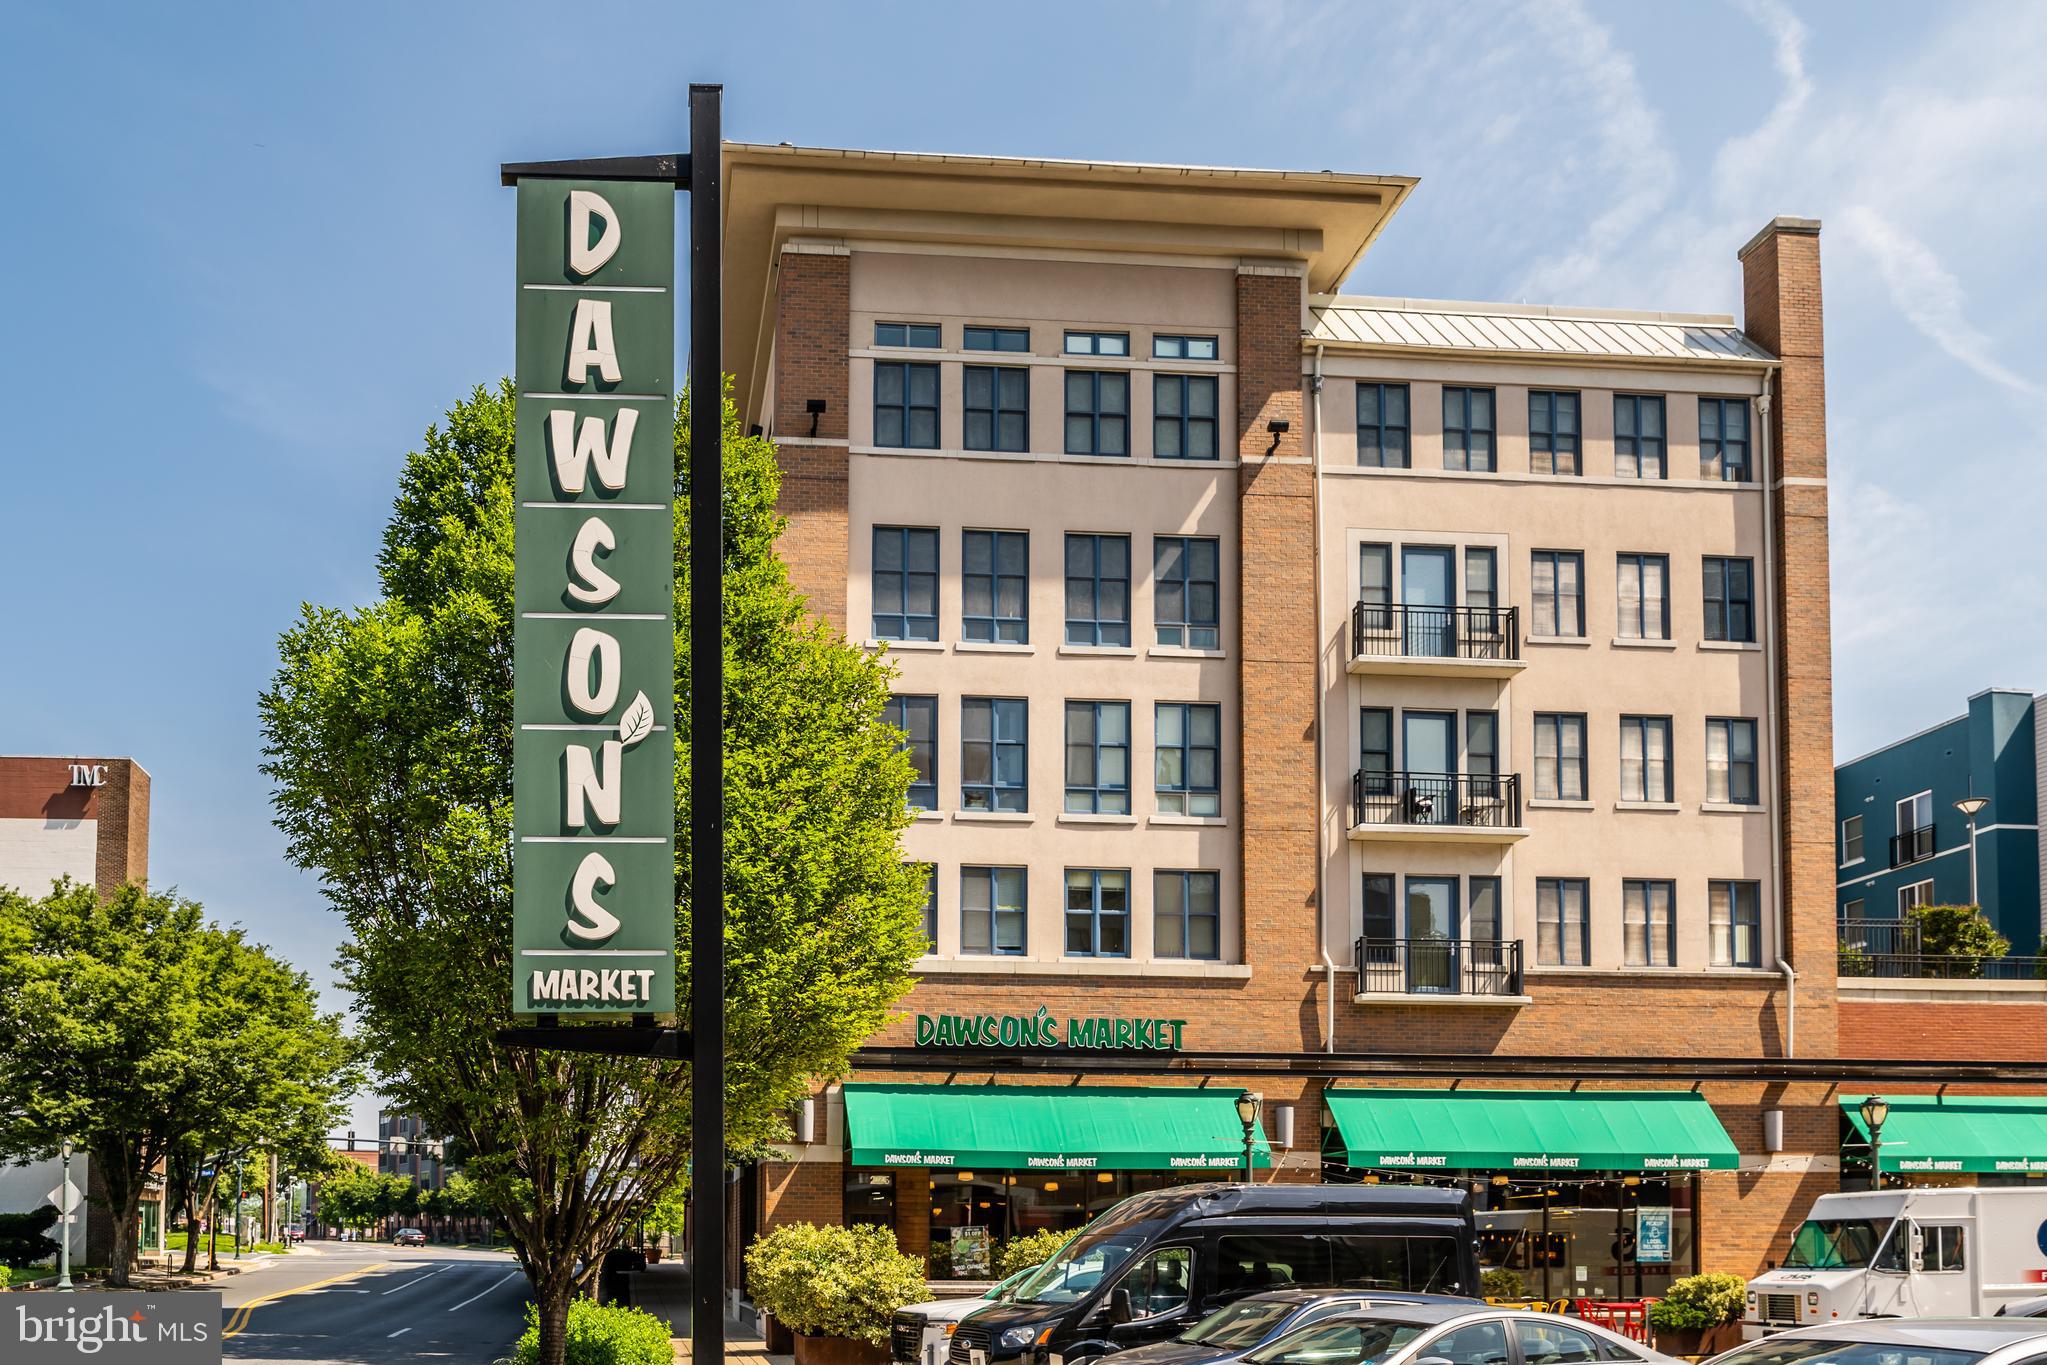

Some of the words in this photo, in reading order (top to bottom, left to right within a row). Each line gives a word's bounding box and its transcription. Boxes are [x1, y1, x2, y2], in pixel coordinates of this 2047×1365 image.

[68, 764, 108, 787] TMC
[533, 969, 655, 1001] MARKET
[1068, 1018, 1187, 1050] MARKET
[924, 1155, 955, 1165] MARKET
[1066, 1157, 1097, 1167] MARKET
[1208, 1157, 1239, 1167] MARKET
[1416, 1156, 1446, 1166] MARKET
[1549, 1158, 1579, 1167] MARKET
[1680, 1158, 1710, 1167] MARKET
[1934, 1161, 1963, 1170] MARKET
